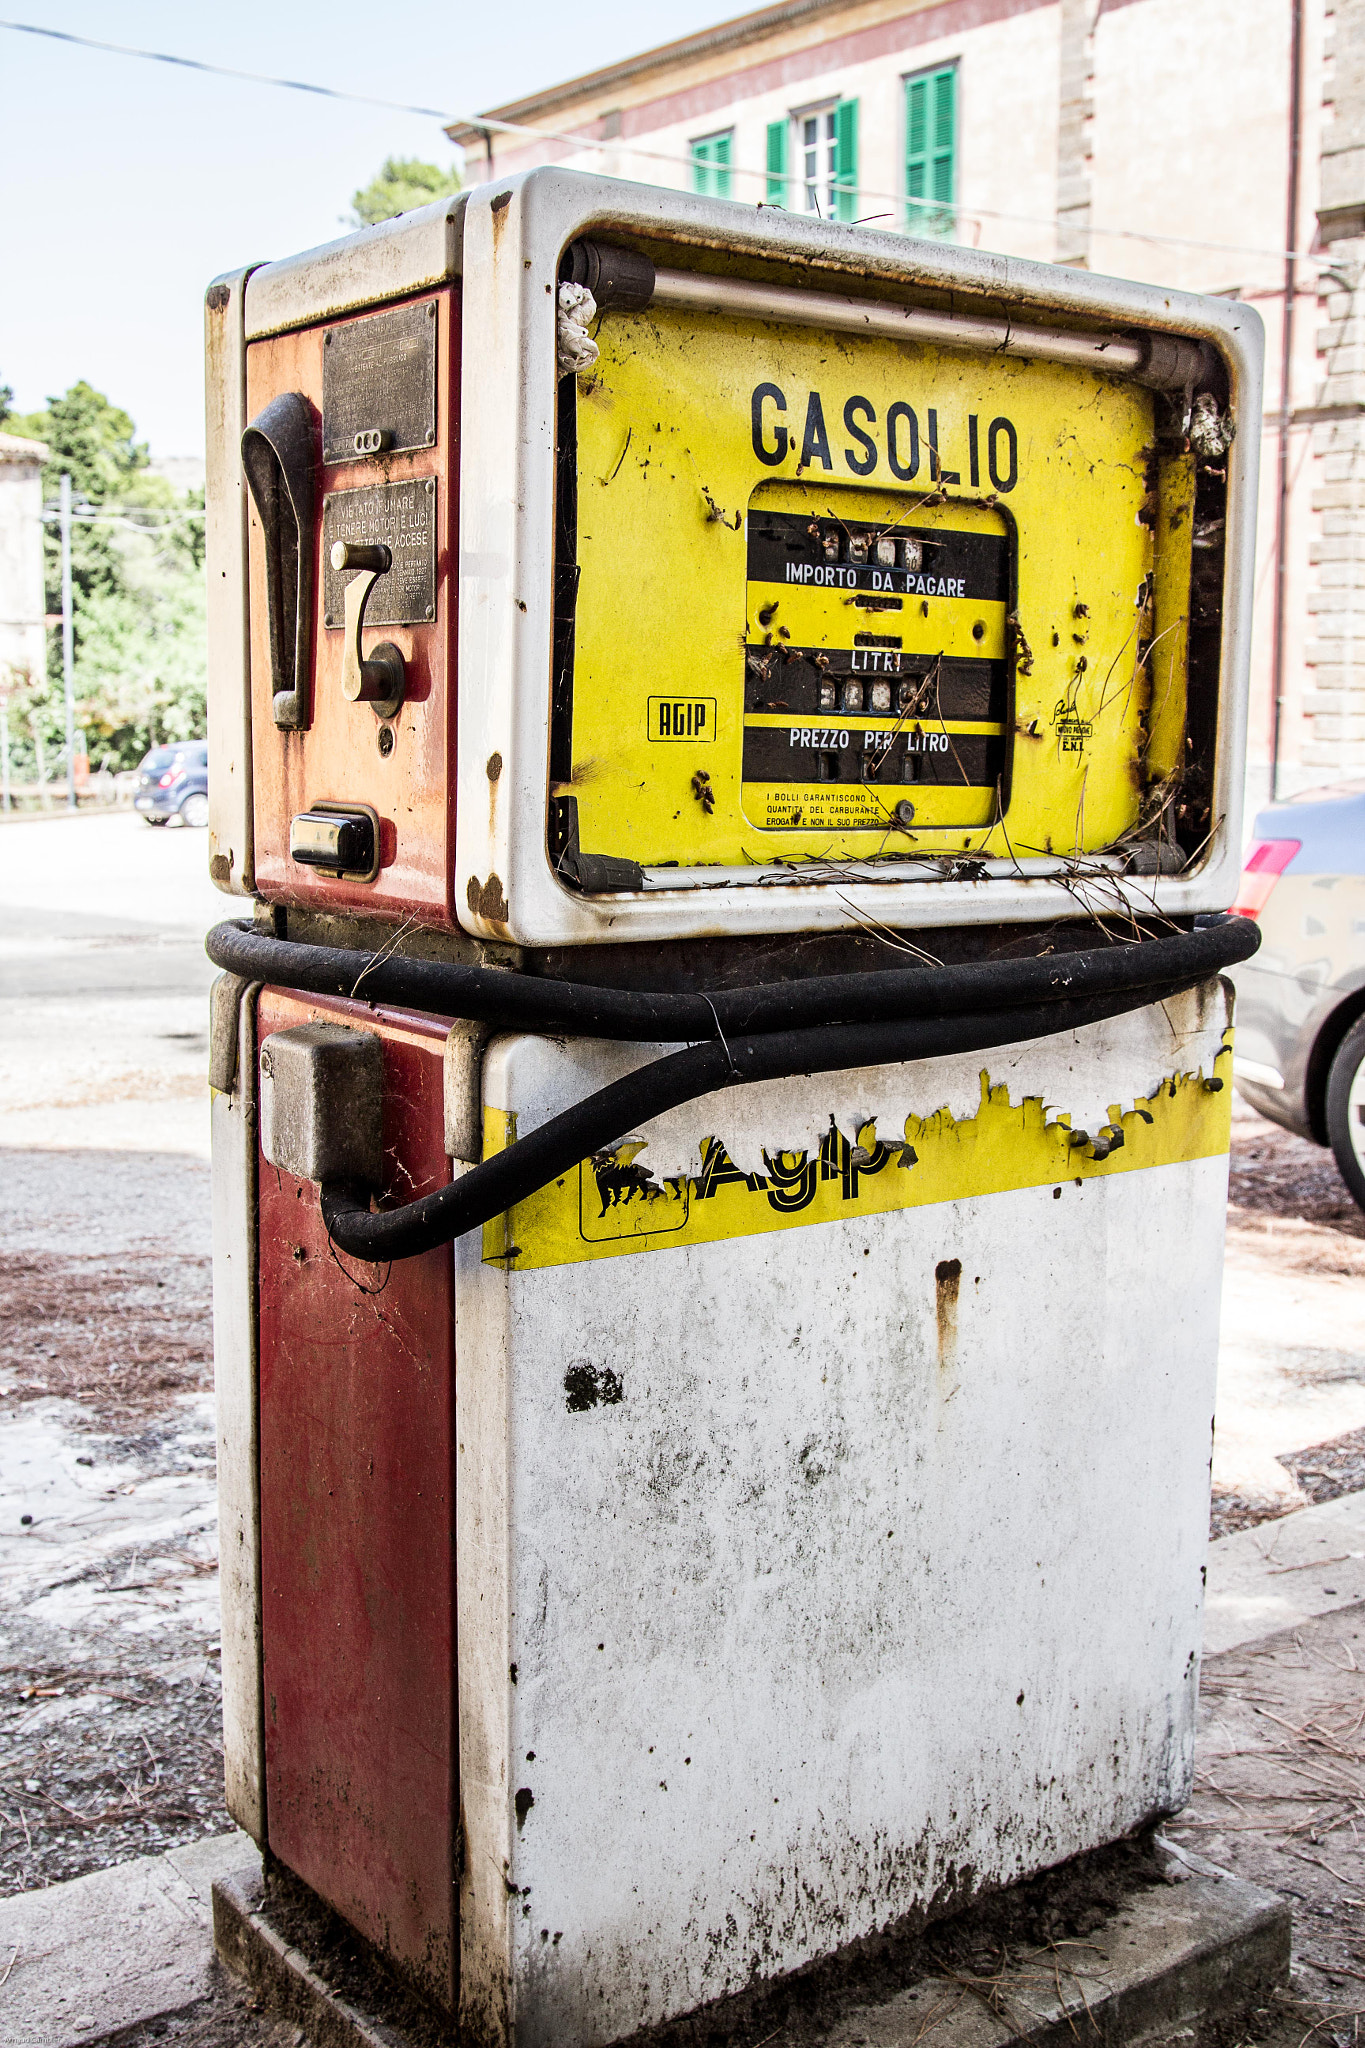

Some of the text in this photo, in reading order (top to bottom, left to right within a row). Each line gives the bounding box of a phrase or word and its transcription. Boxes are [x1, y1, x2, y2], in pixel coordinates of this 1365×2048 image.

[750, 382, 1018, 494] GASOLIO
[341, 502, 374, 518] VIETATO
[336, 521, 367, 537] TENERE
[409, 512, 428, 528] LUCI
[395, 531, 428, 548] ACCESE
[786, 562, 966, 598] IMPORTO DA PAGARE
[851, 650, 902, 672] LITRI
[659, 703, 706, 736] AGIP
[789, 728, 949, 752] PREZZO PER LITRO
[766, 793, 770, 801] I
[774, 793, 799, 801] BOLLI
[803, 793, 866, 802] GARANTISCONO
[809, 806, 824, 814] DEL
[829, 806, 880, 814] CARBURANTE
[802, 818, 807, 826] E
[810, 818, 825, 826] NON
[827, 818, 834, 826] IL
[836, 818, 850, 826] SUO
[853, 818, 880, 826] PREZZO
